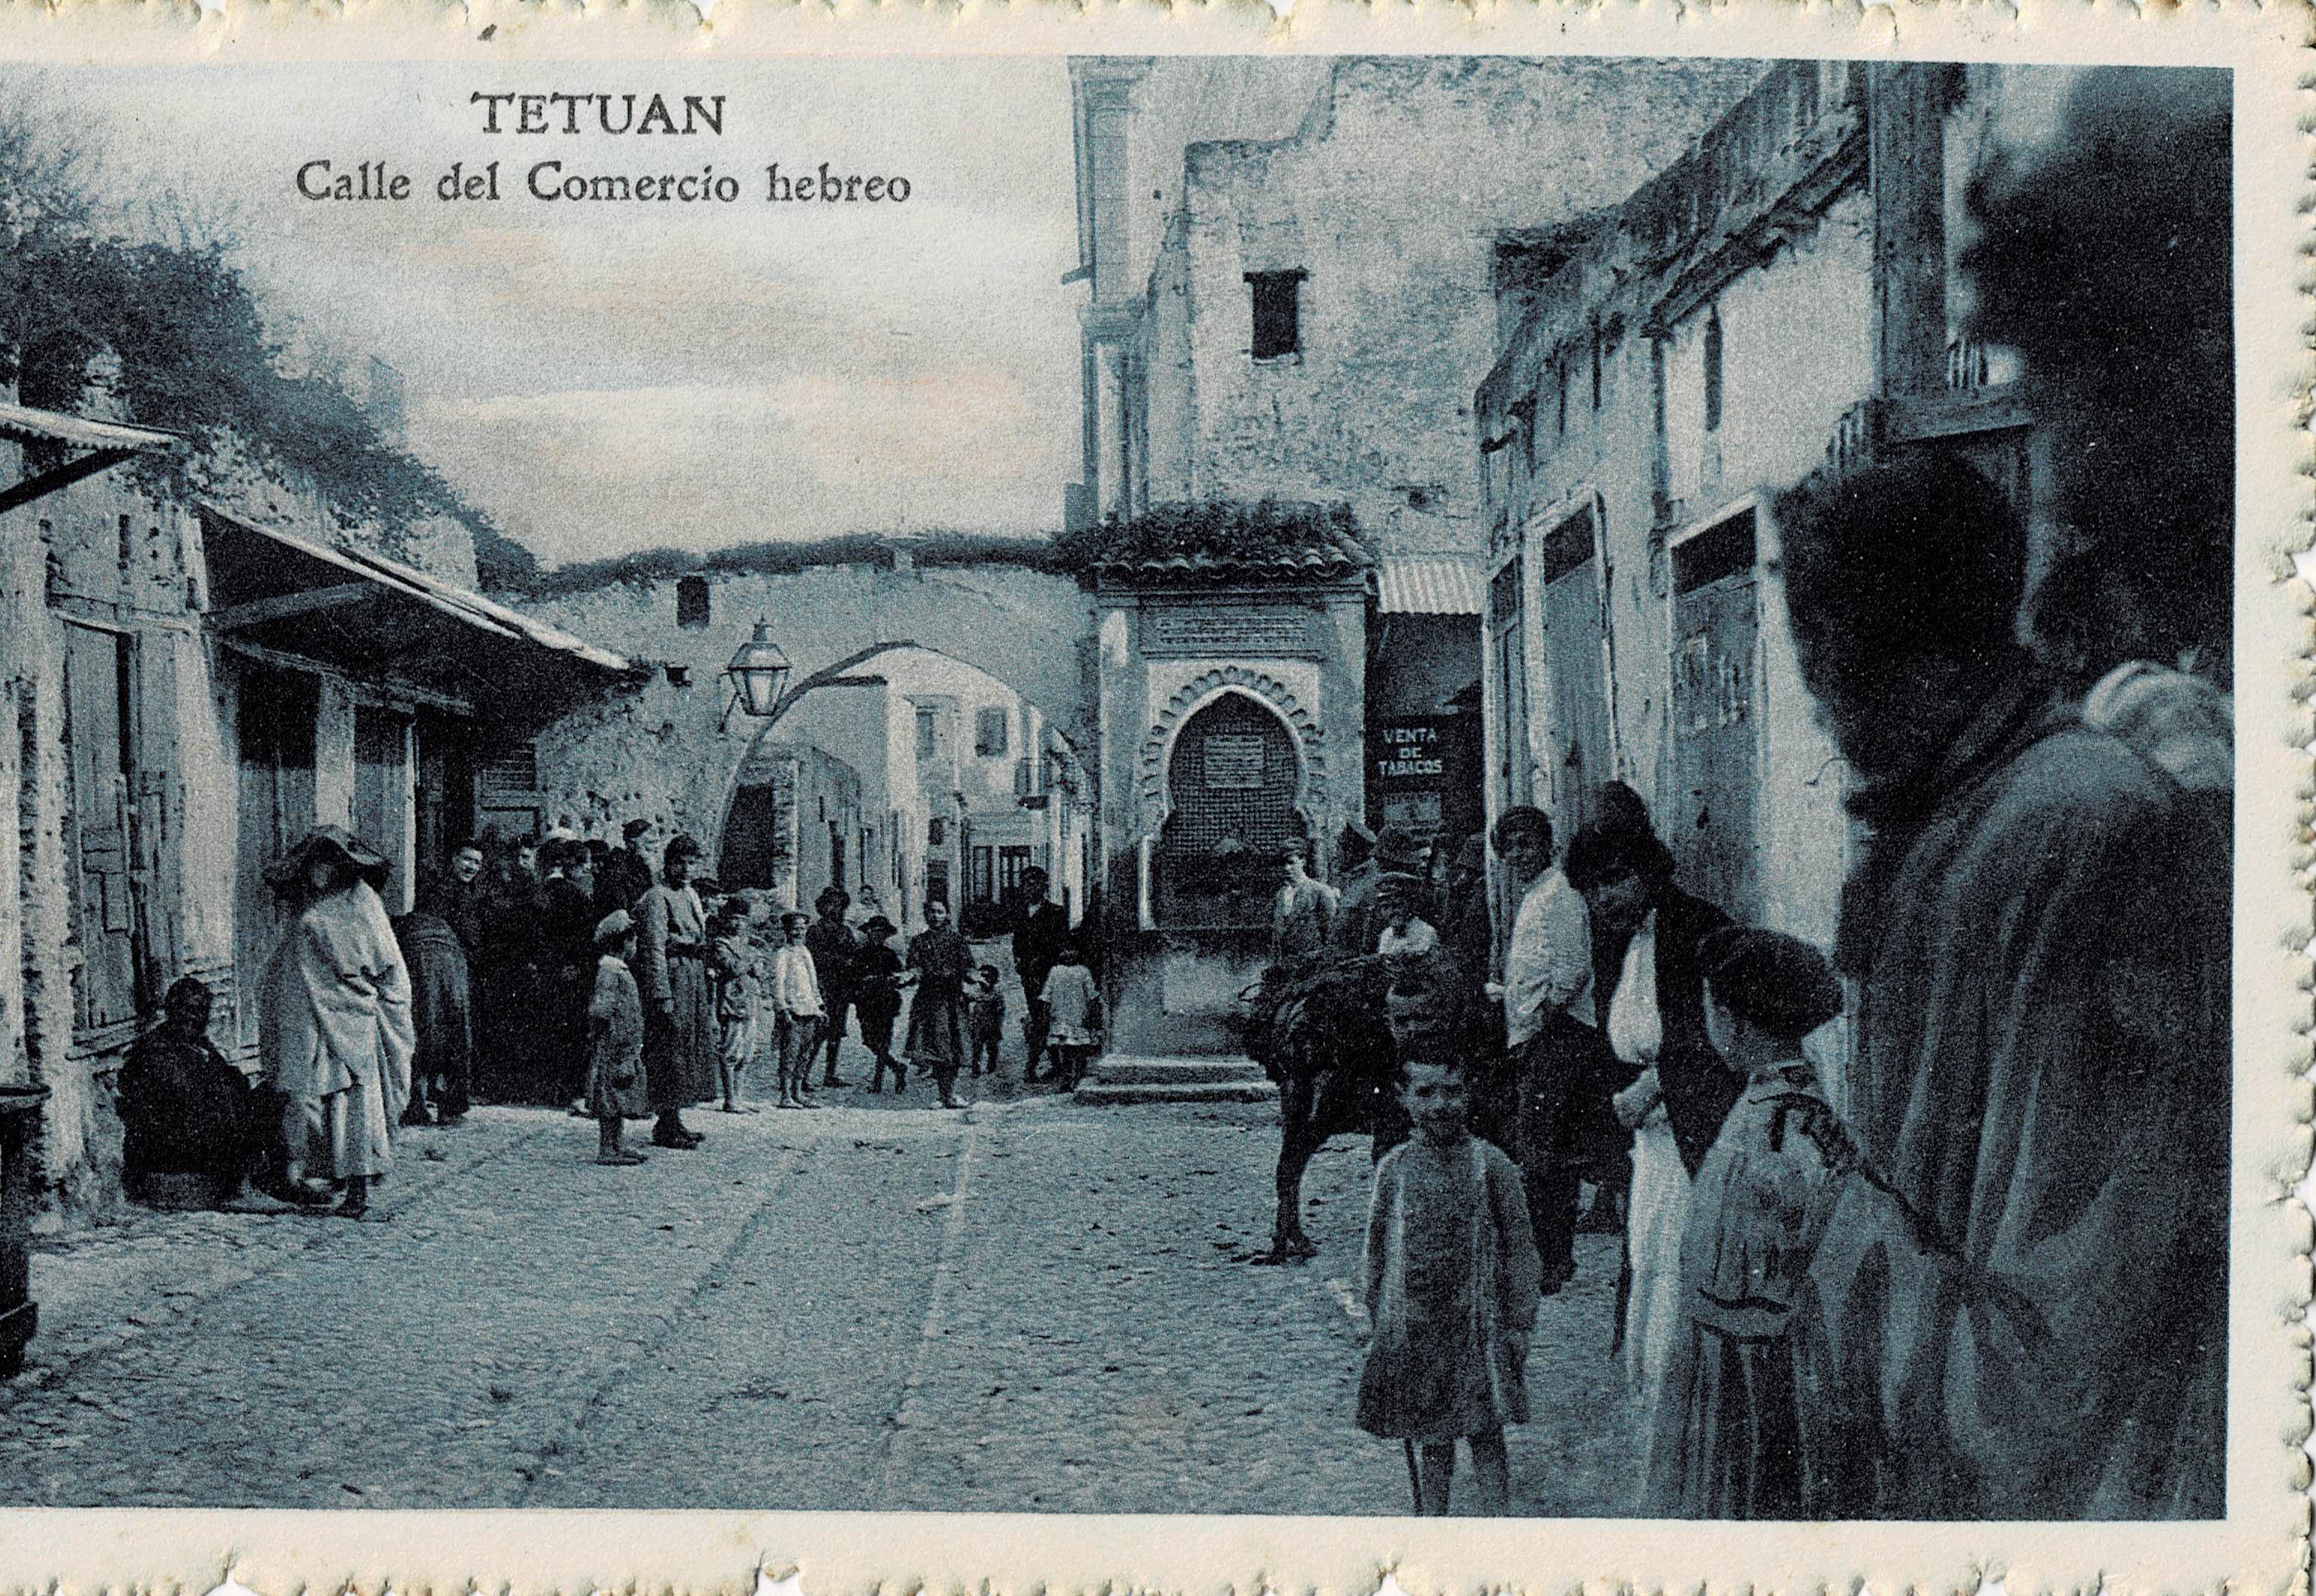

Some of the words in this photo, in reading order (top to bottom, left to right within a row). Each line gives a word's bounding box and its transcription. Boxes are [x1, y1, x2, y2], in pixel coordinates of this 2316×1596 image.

[1383, 727, 1438, 744] VENTA
[1398, 747, 1423, 759] DE
[1378, 759, 1443, 777] TABACOS
